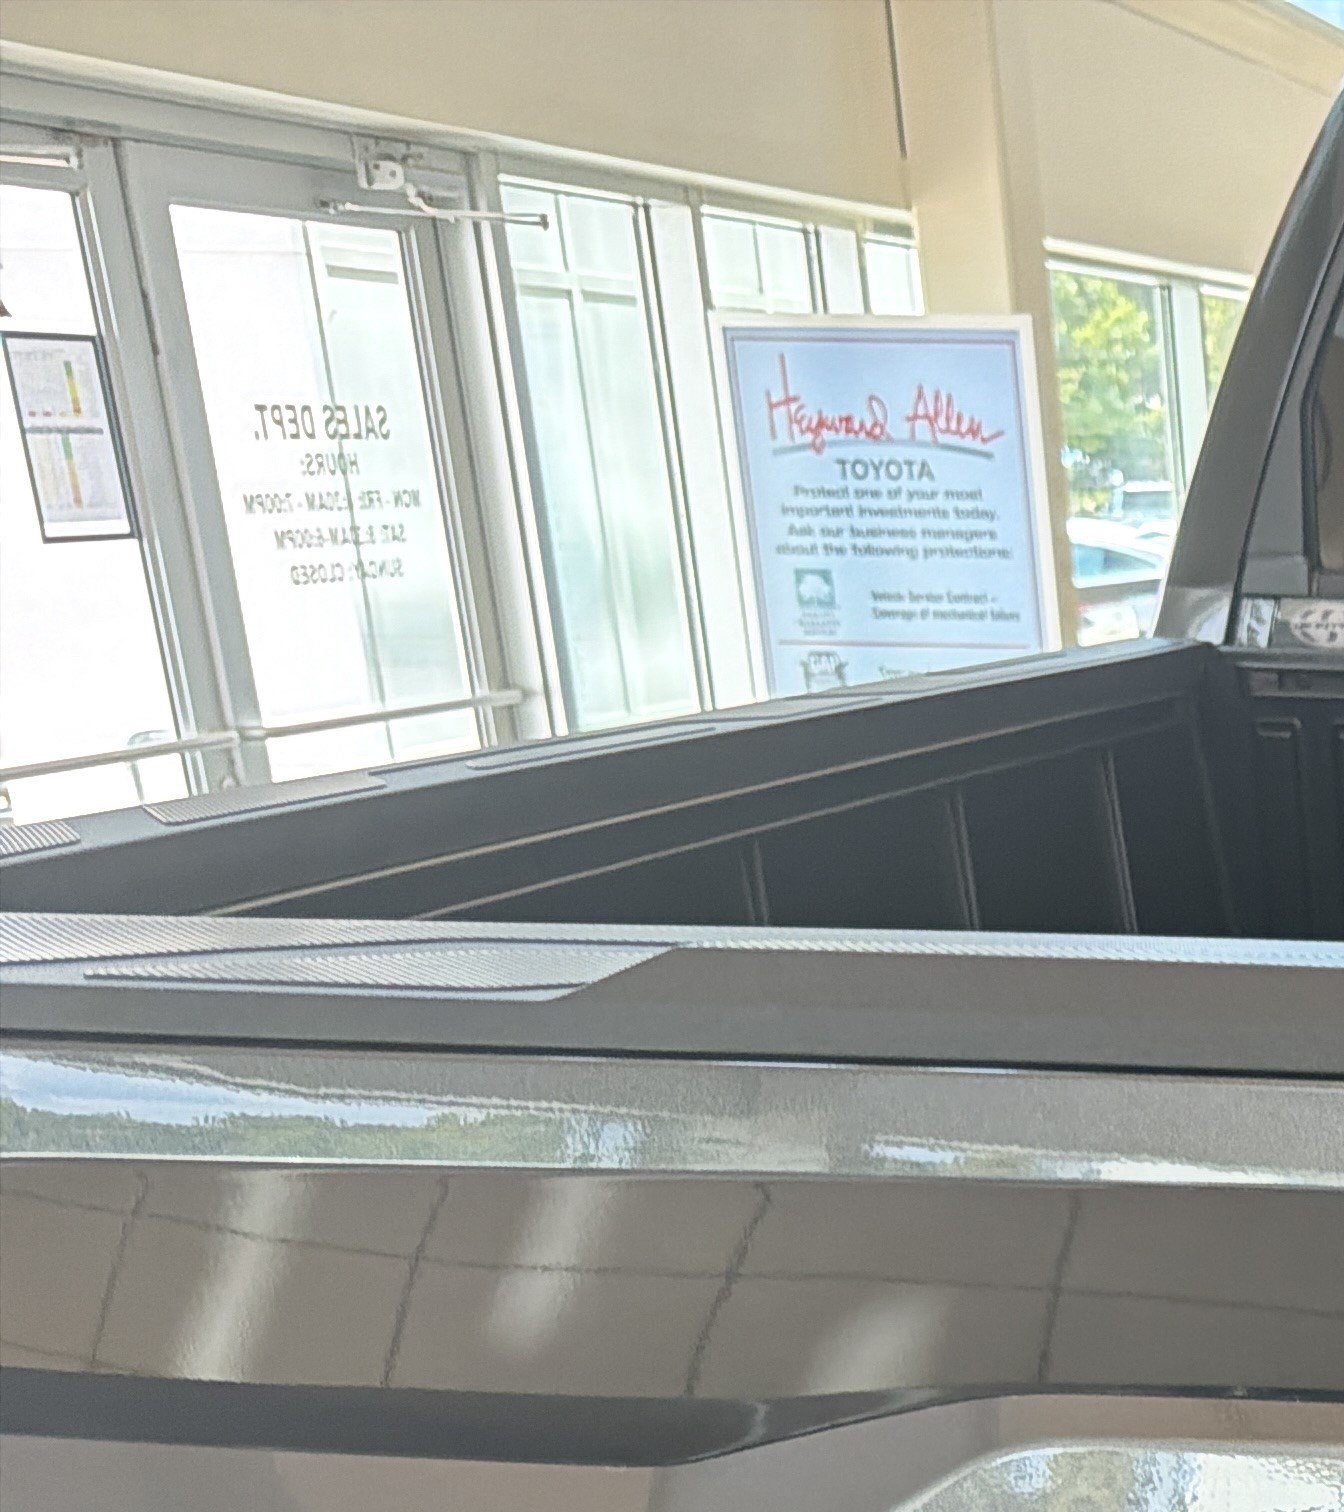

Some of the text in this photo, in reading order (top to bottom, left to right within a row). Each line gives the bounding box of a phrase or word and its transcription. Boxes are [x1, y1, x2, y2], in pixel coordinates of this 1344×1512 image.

[765, 351, 1005, 457] Heyward Allen
[834, 458, 936, 482] TOYOTA
[906, 488, 940, 502] your
